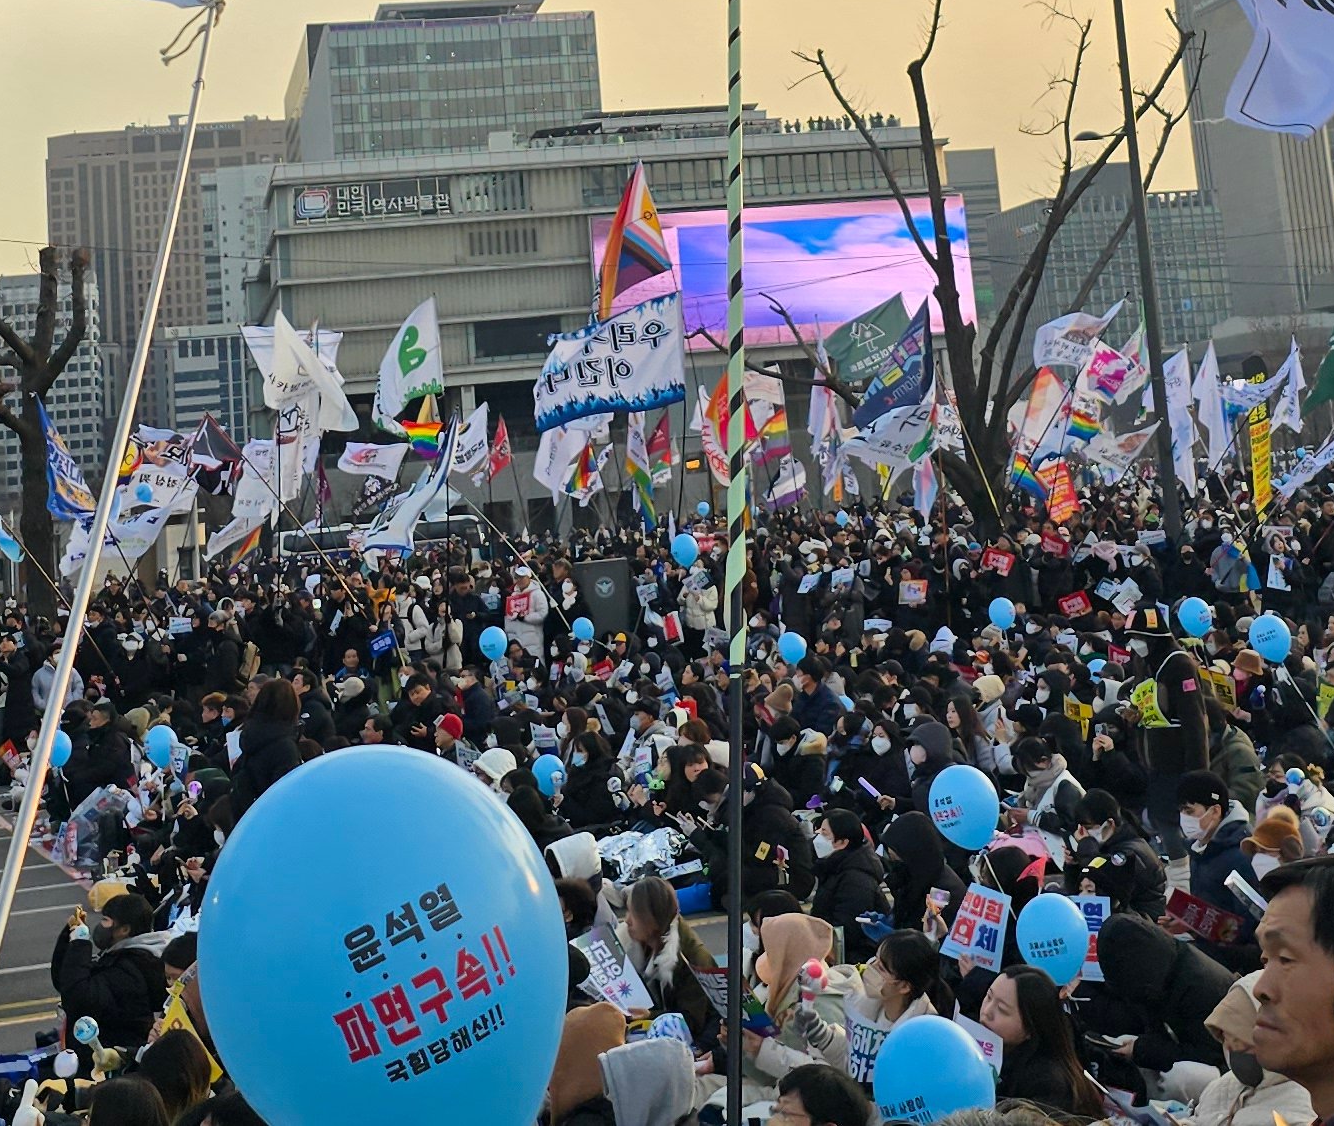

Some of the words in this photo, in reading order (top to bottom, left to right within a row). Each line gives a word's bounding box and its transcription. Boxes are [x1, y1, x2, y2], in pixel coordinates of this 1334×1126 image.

[336, 185, 364, 201] 대한
[371, 193, 451, 214] 역사박물관
[342, 882, 463, 974] 윤석열
[332, 924, 517, 1064] 파면구속!!
[384, 1003, 507, 1084] 국힘당해산!!
